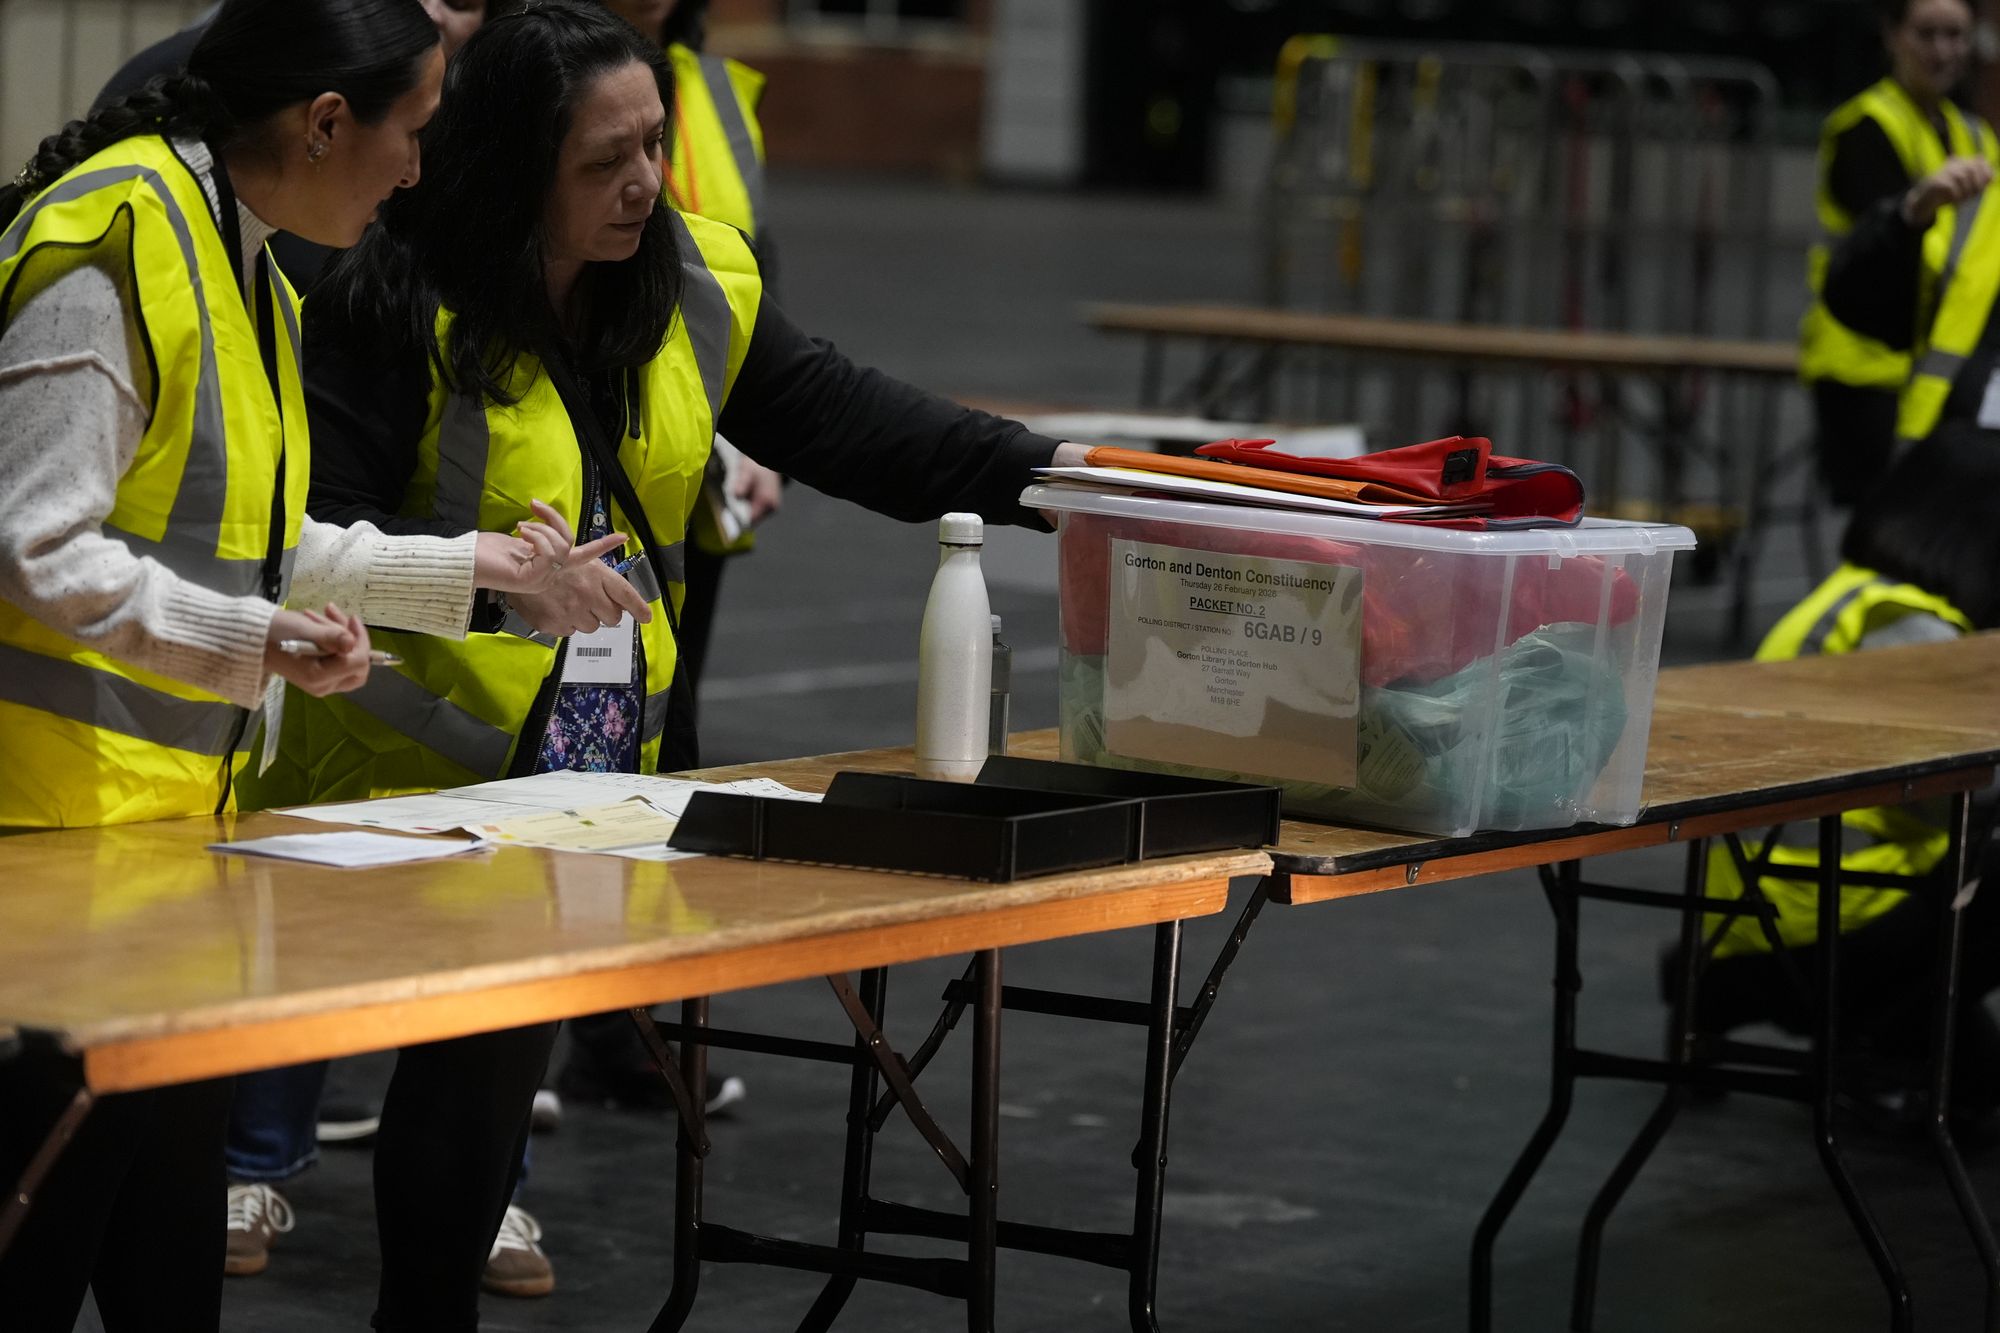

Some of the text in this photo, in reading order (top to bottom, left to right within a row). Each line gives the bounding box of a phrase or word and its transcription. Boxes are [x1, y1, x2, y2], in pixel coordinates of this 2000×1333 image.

[1124, 553, 1335, 595] Gorton and Denton Constituency
[1180, 579, 1277, 598] Thursday 26 February 2026
[1190, 597, 1266, 616] PACKET NO. 2
[1137, 616, 1162, 626] POLLING
[1164, 621, 1190, 630] DISTRICT
[1195, 624, 1220, 635] STATION
[1244, 621, 1295, 643] 6GAB
[1300, 627, 1307, 645] /
[1312, 629, 1322, 646] 9
[1177, 650, 1200, 661] Gorton
[1202, 655, 1226, 666] Library
[1236, 660, 1261, 669] Gorton
[1263, 663, 1278, 671] Hub
[1201, 645, 1248, 657] POLLING PLACE
[1201, 664, 1209, 672] 27
[1236, 669, 1251, 679] Way
[1215, 675, 1237, 686] Gorton
[1206, 685, 1245, 697] Manchester
